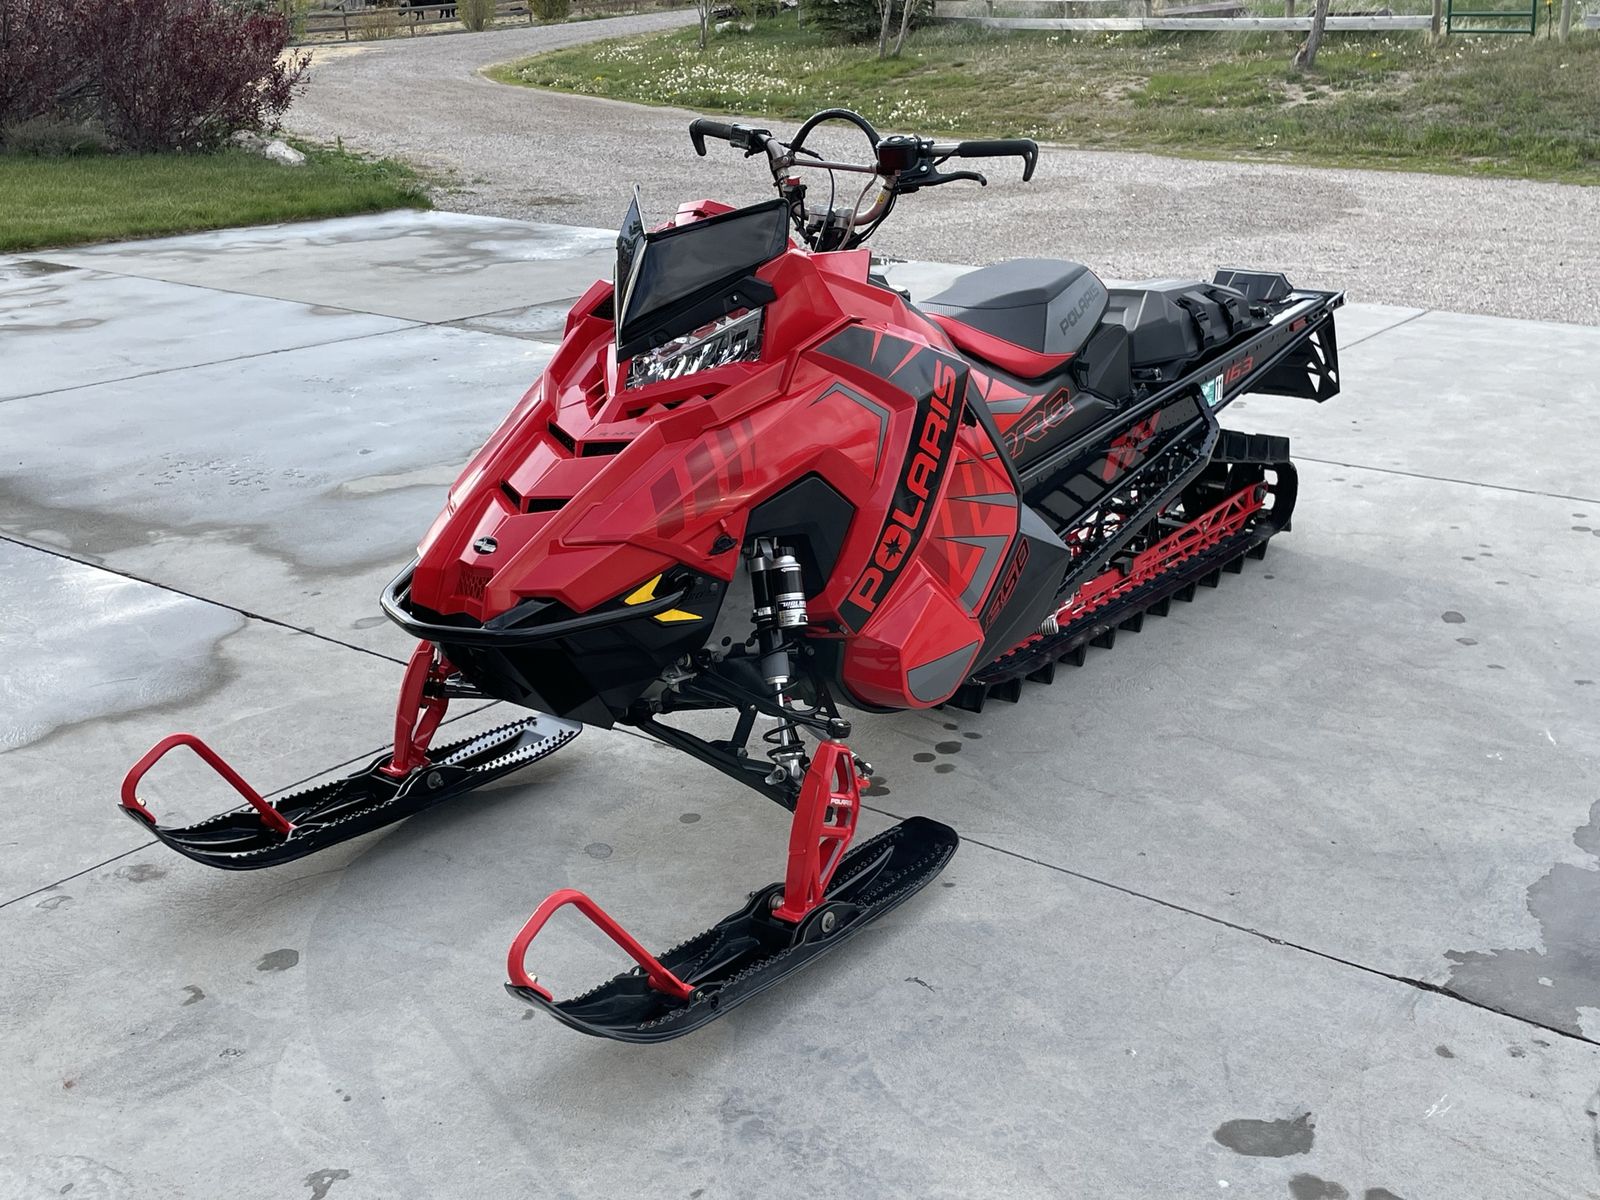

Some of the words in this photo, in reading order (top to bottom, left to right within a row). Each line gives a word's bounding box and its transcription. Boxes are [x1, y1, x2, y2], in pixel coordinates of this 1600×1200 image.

[1058, 283, 1100, 337] POLARIS
[1225, 356, 1254, 385] 163
[853, 359, 956, 613] POLARIS
